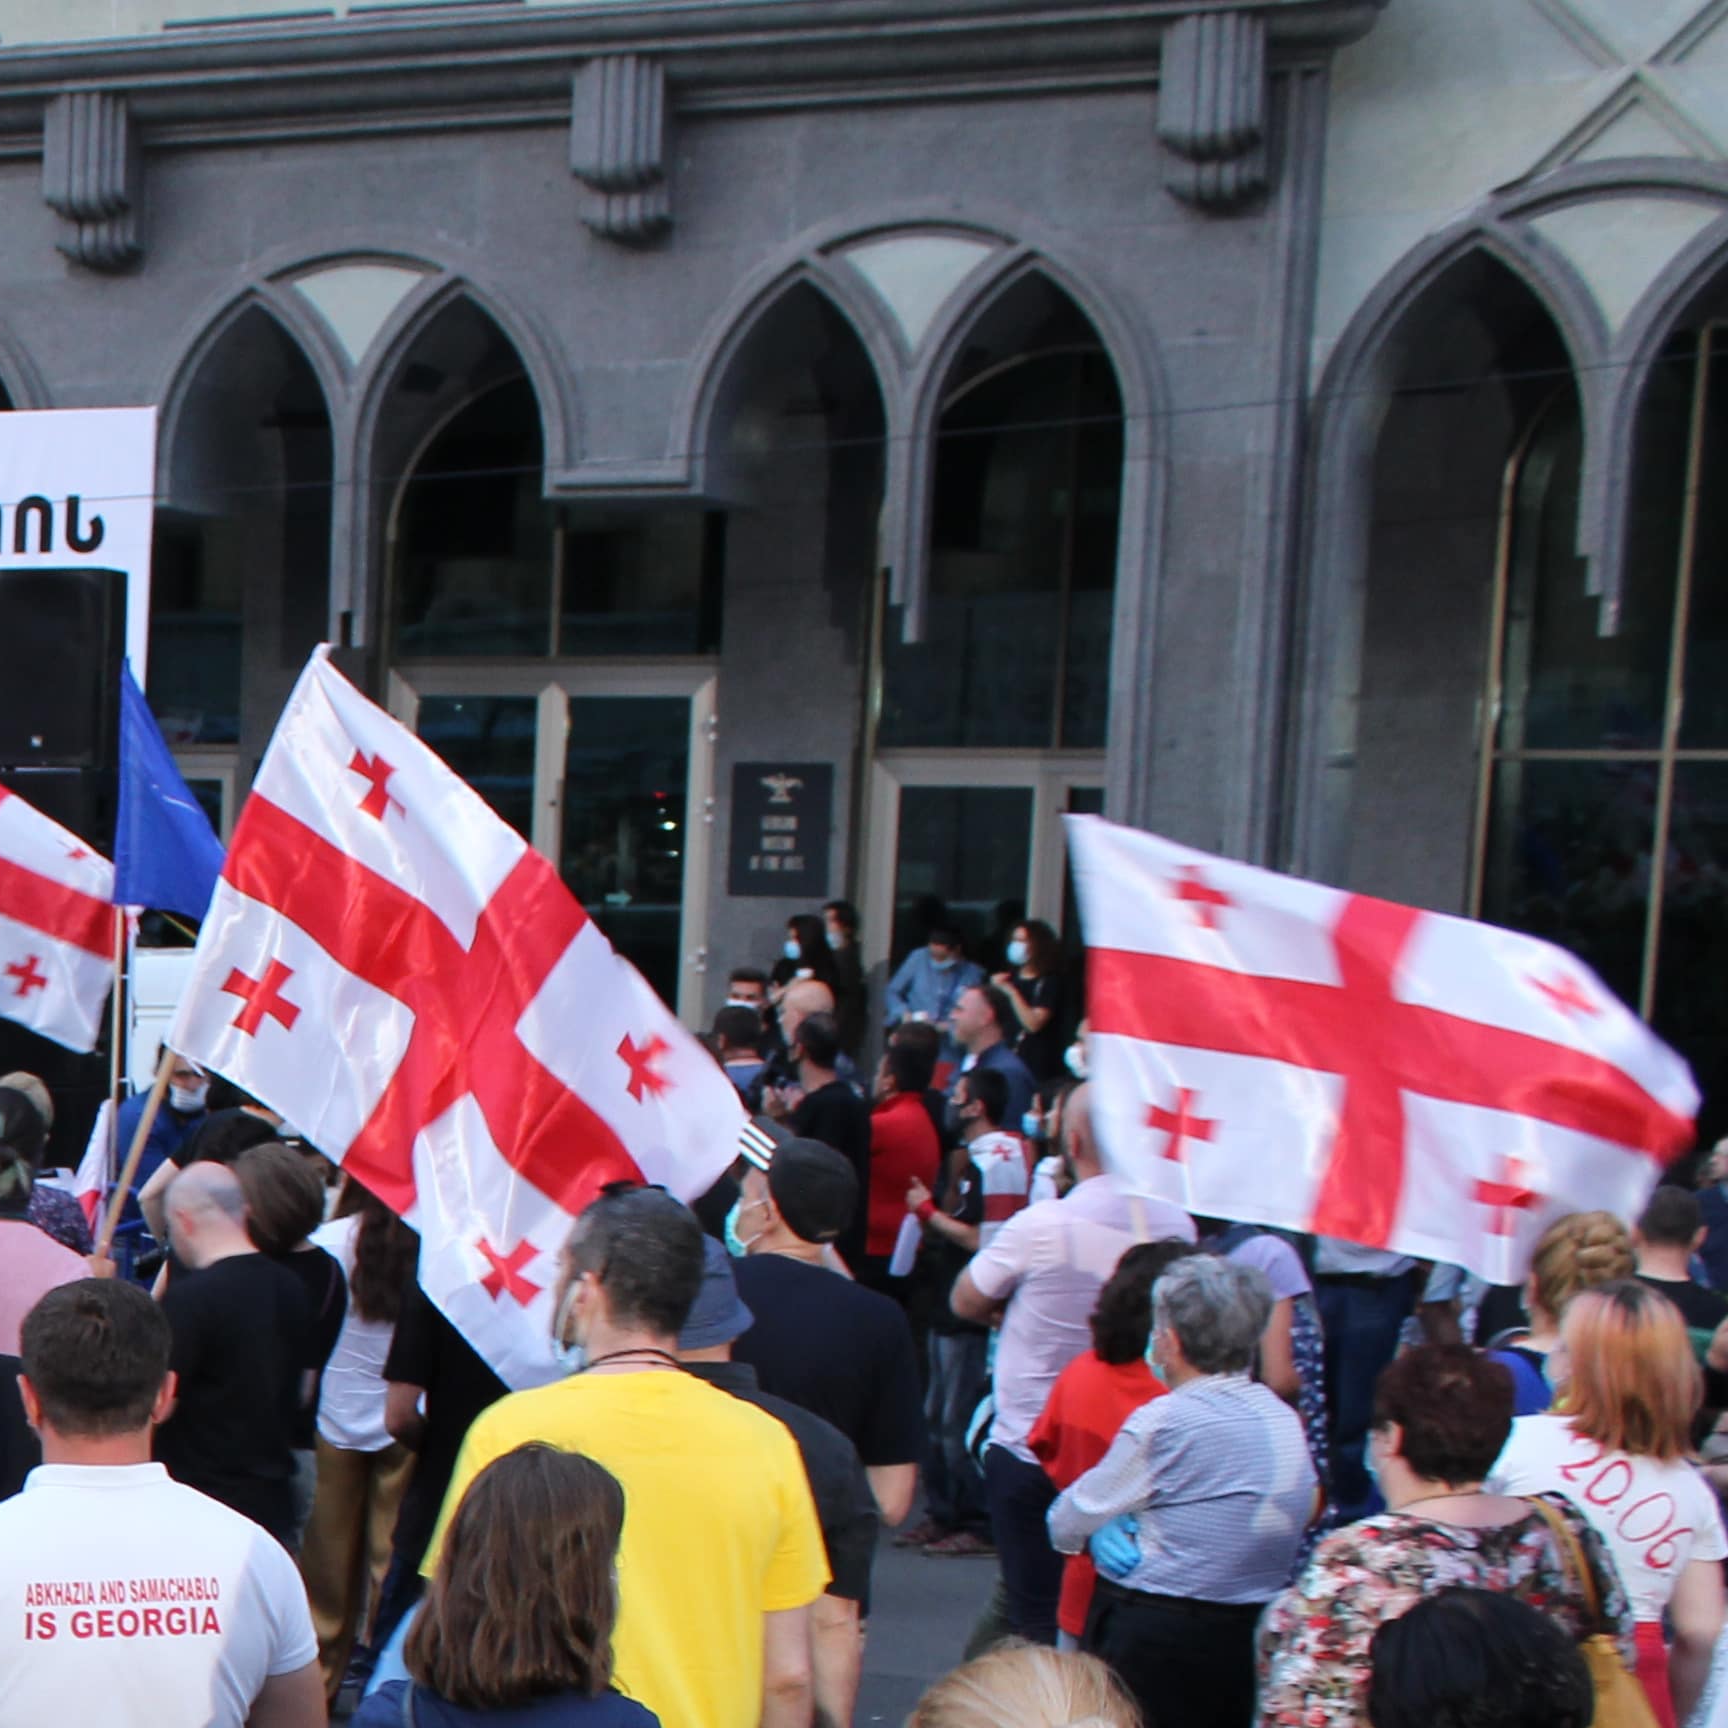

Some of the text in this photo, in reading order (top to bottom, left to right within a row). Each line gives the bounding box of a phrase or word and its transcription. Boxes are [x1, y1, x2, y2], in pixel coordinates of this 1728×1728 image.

[26, 1577, 220, 1606] ABKHAZIA AND SAMACHABLO
[25, 1606, 221, 1641] IS GEORGIA
